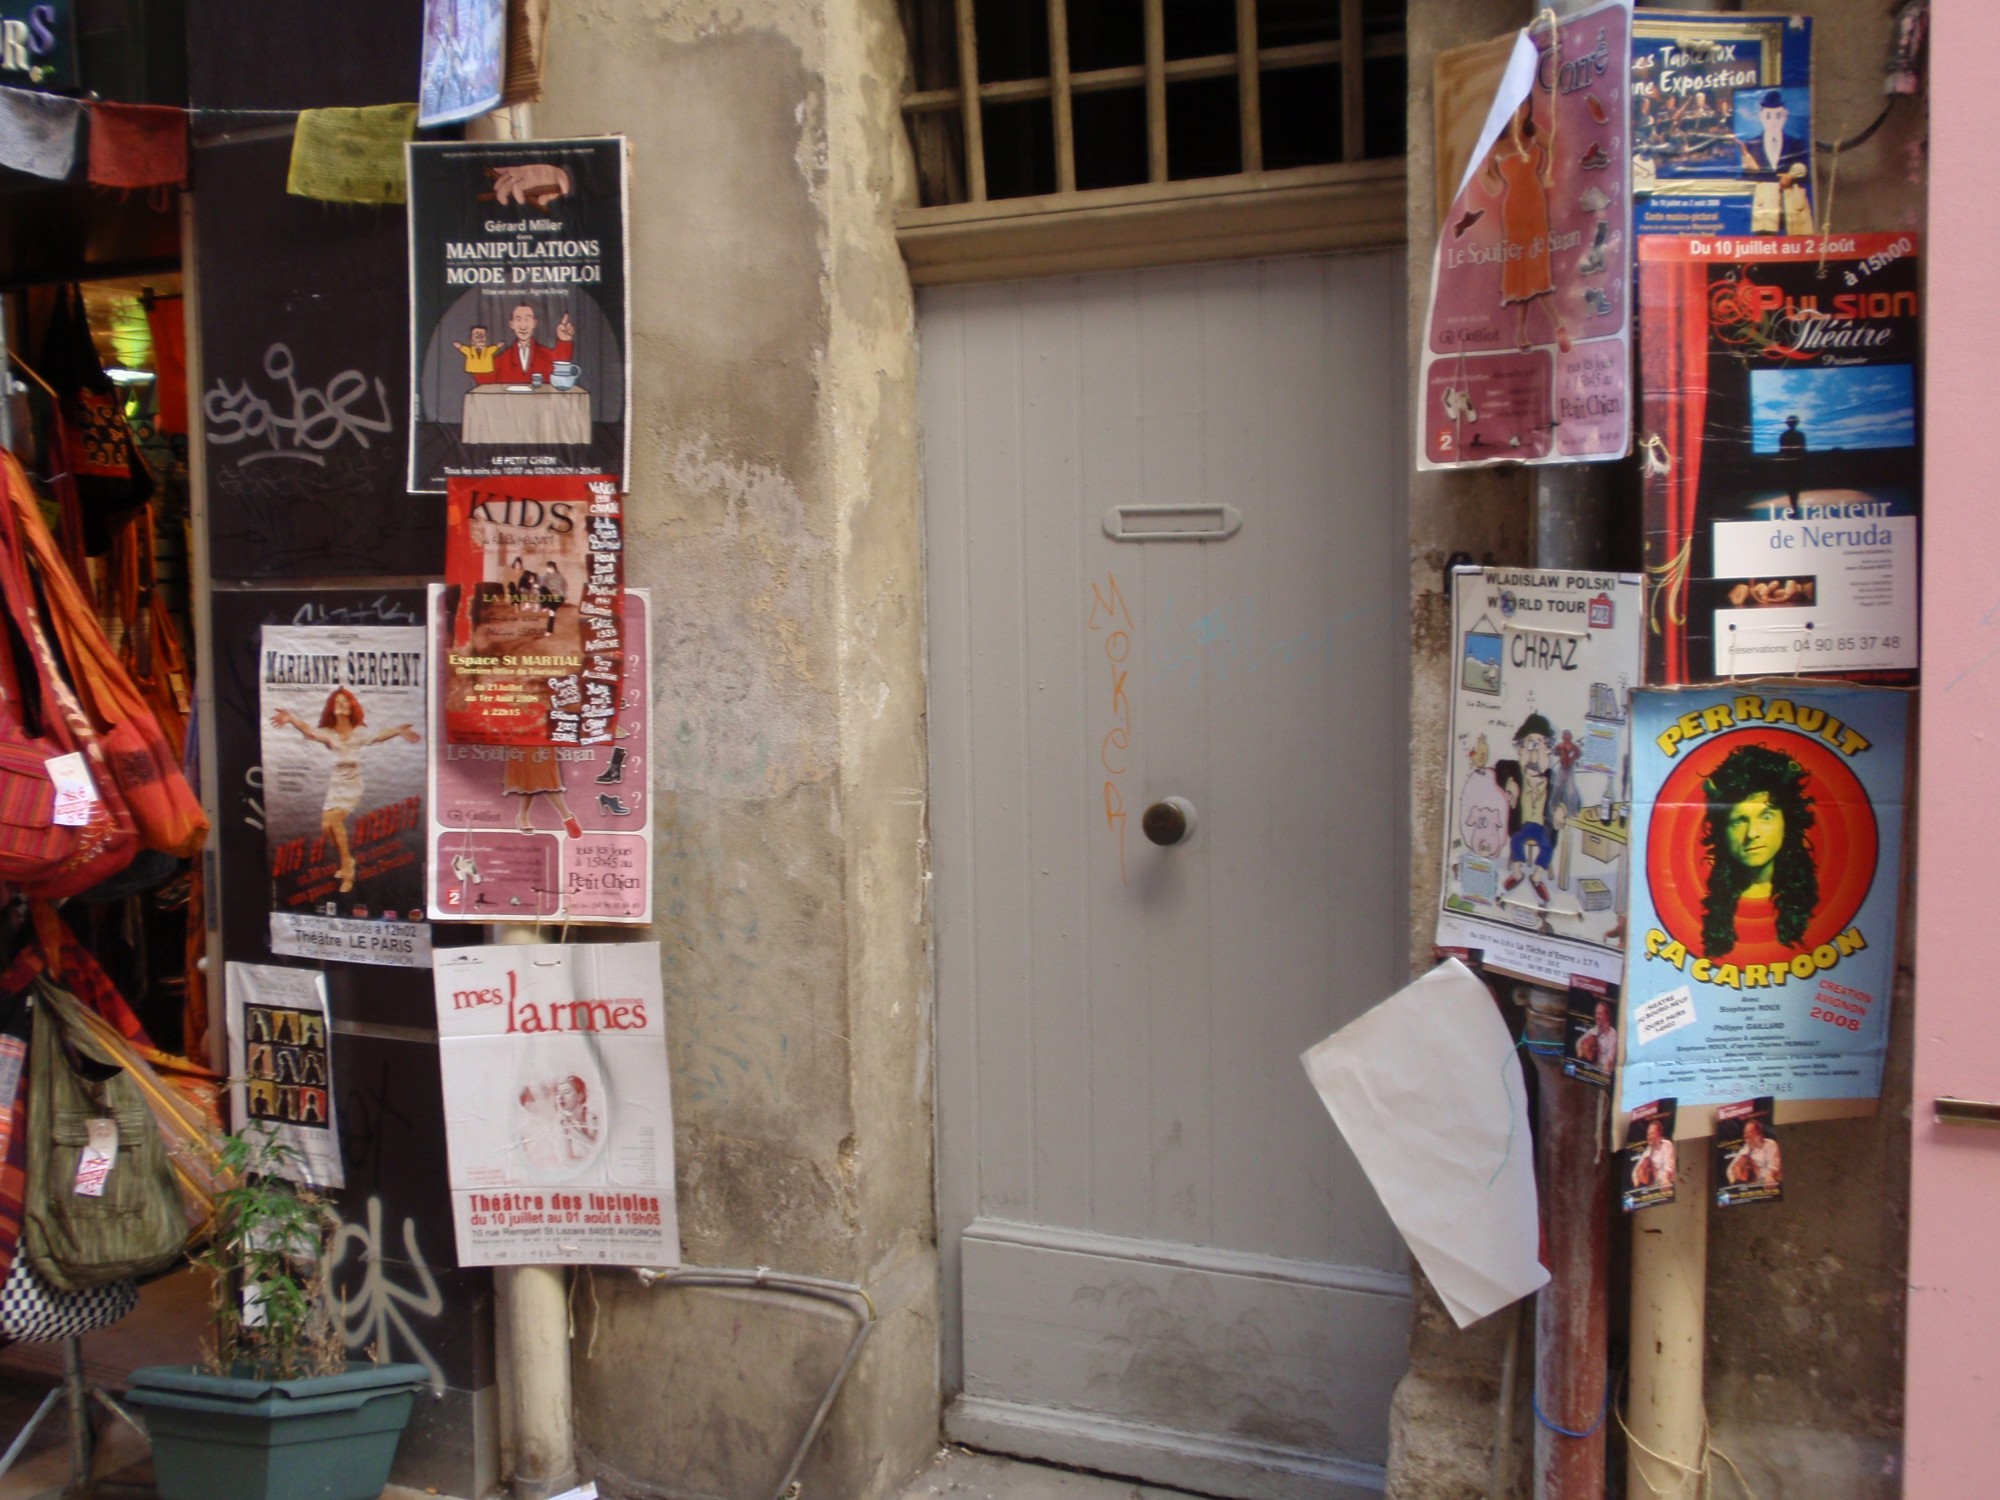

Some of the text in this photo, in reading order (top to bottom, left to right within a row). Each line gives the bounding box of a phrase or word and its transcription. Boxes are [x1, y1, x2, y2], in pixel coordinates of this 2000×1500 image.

[0, 5, 55, 71] RS
[1660, 69, 1756, 97] Exposition
[484, 217, 563, 233] Gérard Miller
[446, 240, 601, 259] MANIPULATIONS
[1448, 247, 1466, 269] Le
[1528, 235, 1545, 259] de
[1690, 238, 1856, 259] Du 10 juillet au 2 août
[1844, 237, 1912, 287] à 15h00
[446, 264, 602, 284] MODE D'EMPLOI
[1774, 309, 1892, 353] Théâtre
[1587, 394, 1620, 416] Chien
[1439, 434, 1452, 451] 2
[491, 456, 503, 465] LE
[504, 456, 528, 465] PETIT
[466, 490, 575, 534] KIDS
[1770, 499, 1892, 521] Le facteur
[1769, 523, 1892, 549] de Neruda
[1486, 573, 1616, 591] WLADISLAW POLSKI
[1547, 599, 1587, 614] TOUR
[1510, 632, 1578, 671] CHRAZ
[1793, 638, 1811, 652] 04
[1815, 638, 1833, 651] 90
[1837, 637, 1855, 650] 85
[1859, 636, 1877, 650] 37
[1881, 635, 1900, 649] 48
[266, 650, 420, 687] MARIANNE SERGENT
[449, 654, 582, 667] Espace St MARTIAL
[1655, 695, 1872, 757] PERRAULT
[446, 744, 468, 761] Le
[531, 744, 550, 763] de
[620, 860, 633, 868] au
[568, 872, 641, 890] Petit Chien
[449, 892, 461, 905] 2
[294, 929, 414, 954] Théâtre LE PARIS
[1644, 927, 1869, 989] ÇA CARTOON
[452, 969, 648, 1035] mes larmes
[1819, 979, 1874, 1004] CREATION
[1758, 1004, 1782, 1012] ROUX
[1814, 992, 1868, 1016] AVIGNON
[1713, 1022, 1785, 1032] Philippe GAILLARD
[1809, 1006, 1861, 1032] 2008
[469, 1193, 660, 1213] Théâtre des lucioles
[471, 1212, 662, 1228] du 10 juillet au 01 août à 19h05
[472, 1229, 484, 1238] 10
[485, 1230, 500, 1238] rue
[502, 1227, 542, 1239] Rempart
[544, 1227, 553, 1236] St
[555, 1227, 586, 1236] Lazare
[618, 1227, 662, 1238] AVIGNON
